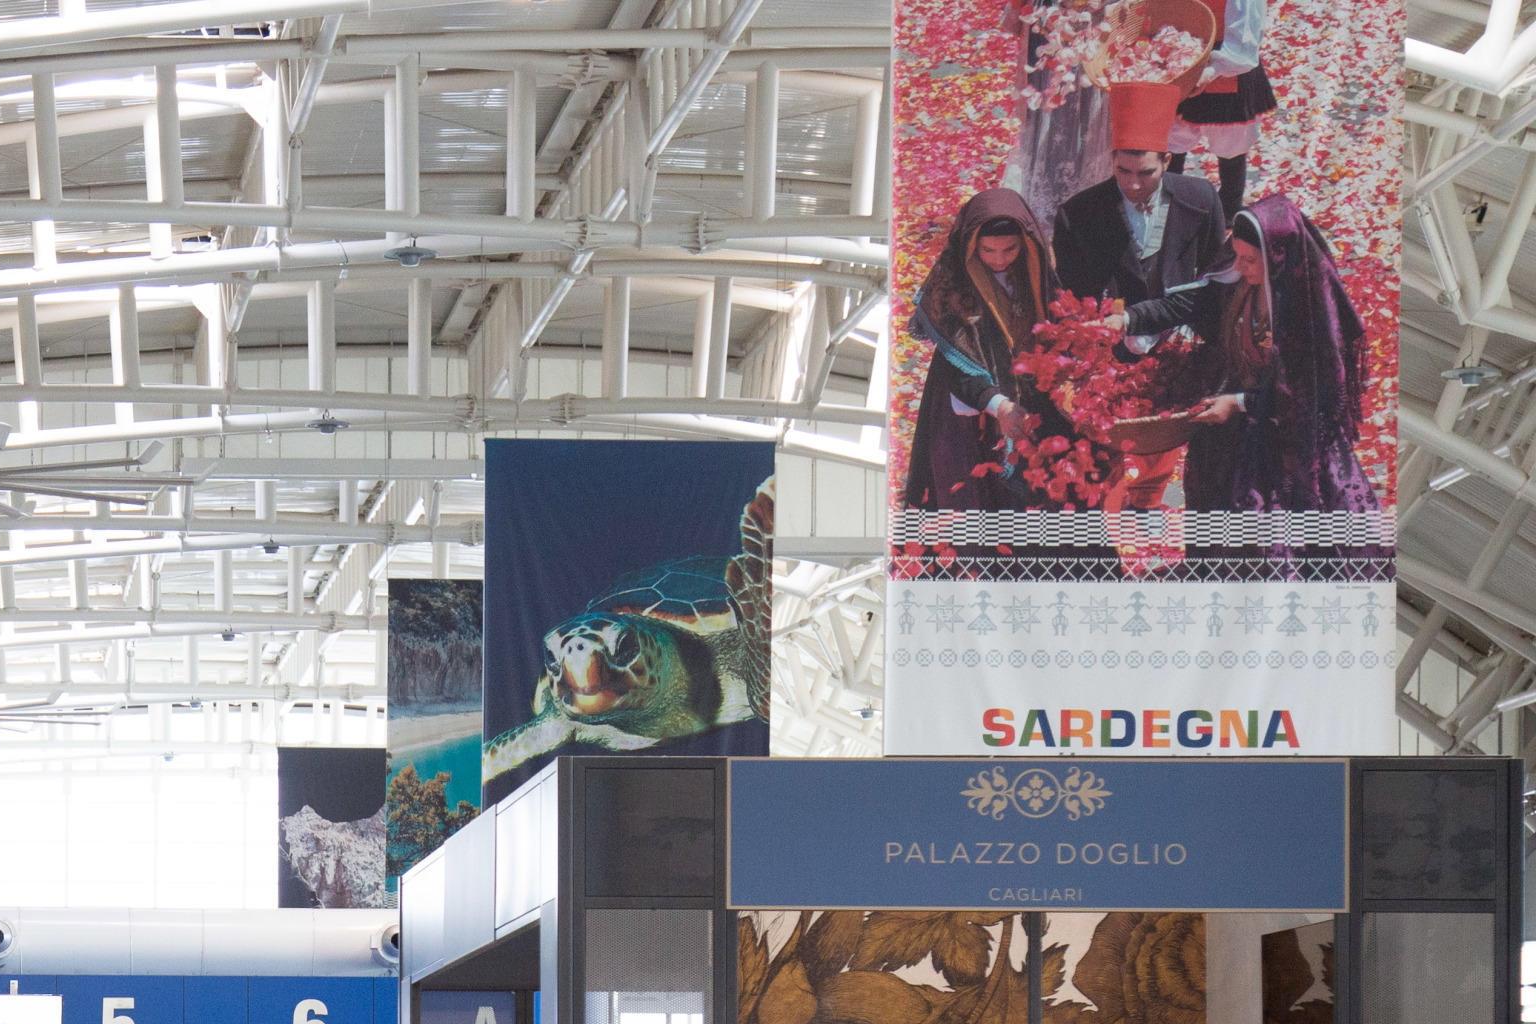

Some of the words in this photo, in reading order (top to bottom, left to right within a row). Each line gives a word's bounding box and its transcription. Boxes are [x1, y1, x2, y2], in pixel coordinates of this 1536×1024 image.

[981, 707, 1302, 749] SARDEGNA
[884, 842, 1042, 866] PALAZZO
[1056, 842, 1189, 866] DOGLIO
[988, 887, 1084, 903] CAGLIARI
